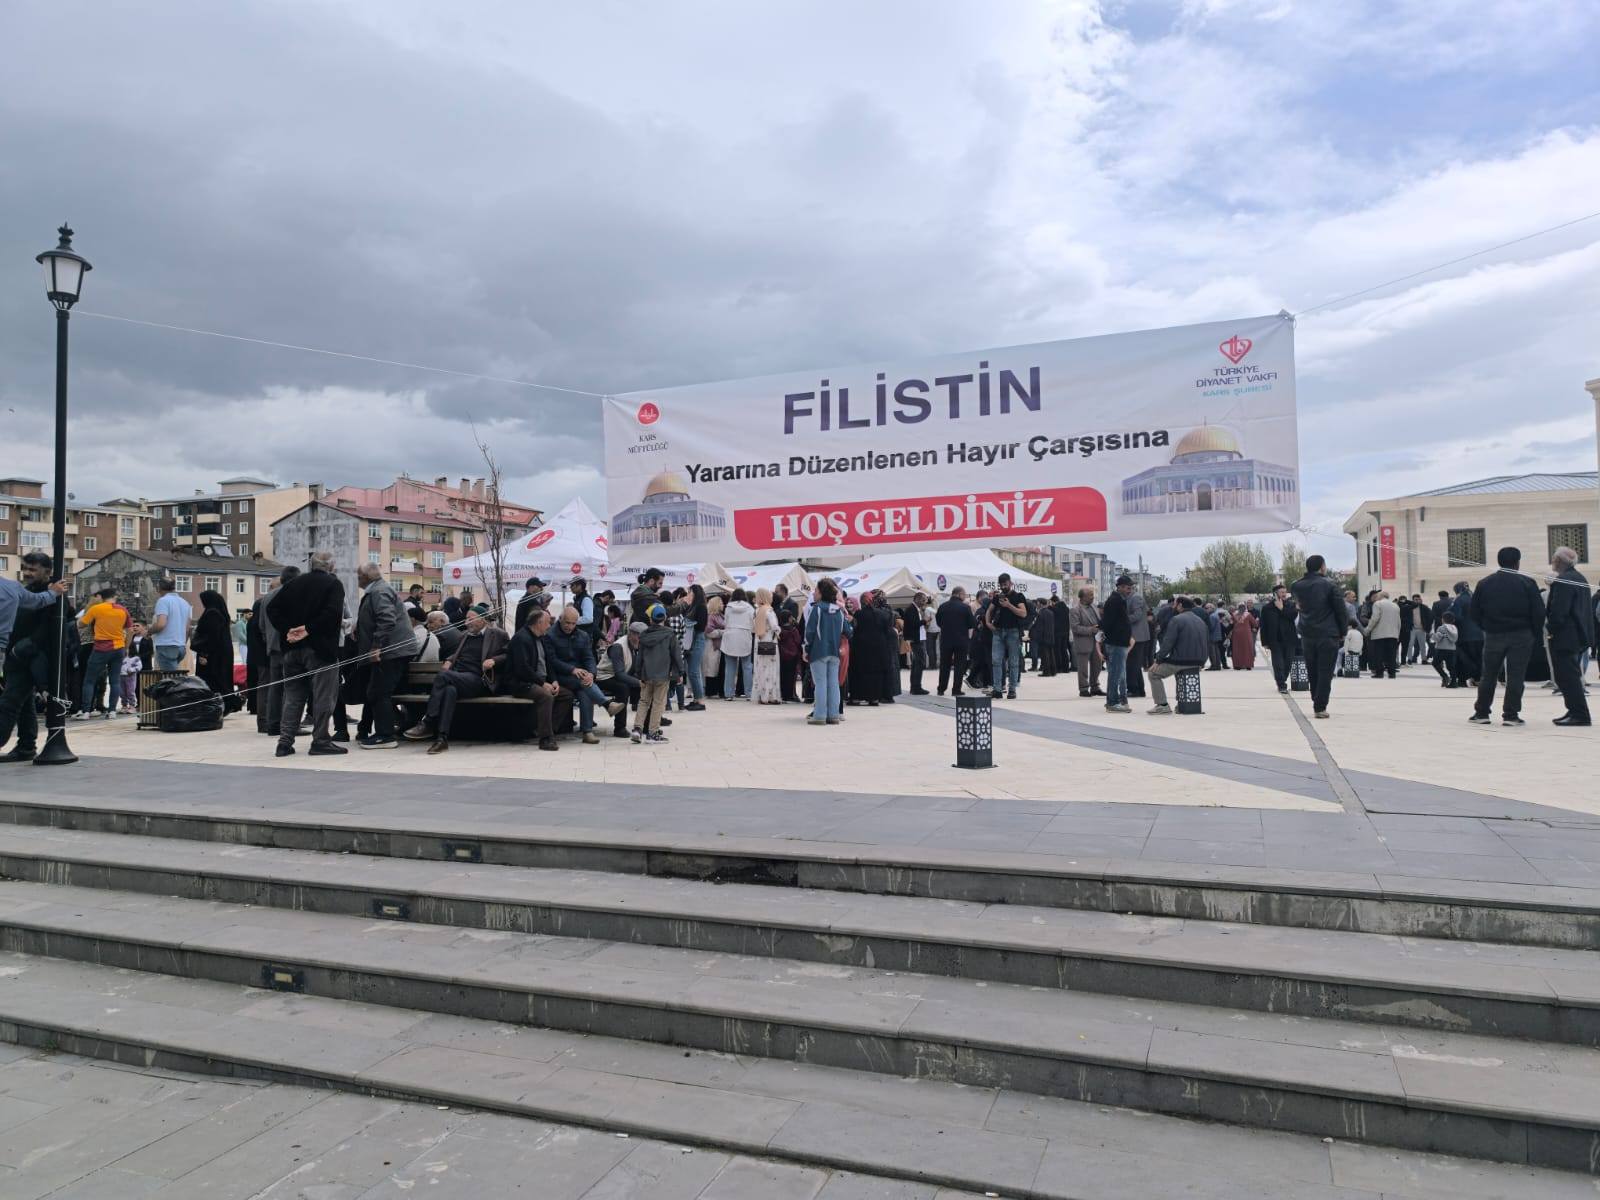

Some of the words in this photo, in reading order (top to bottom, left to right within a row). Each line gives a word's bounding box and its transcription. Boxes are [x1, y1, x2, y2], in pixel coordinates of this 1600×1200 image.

[1214, 365, 1260, 376] TÜRKİYE
[1196, 376, 1241, 388] DİYANET
[1246, 372, 1278, 383] VAKFI
[783, 360, 1041, 435] FİLİSTİN
[639, 433, 657, 442] KARS
[685, 459, 781, 484] Yararına
[788, 448, 938, 476] Düzenlenen
[946, 441, 1020, 466] Hayır
[1028, 429, 1170, 462] Çarşısına
[770, 510, 849, 546] HOŞ
[854, 490, 1055, 538] GELDİNİZ
[978, 580, 996, 590] KARS
